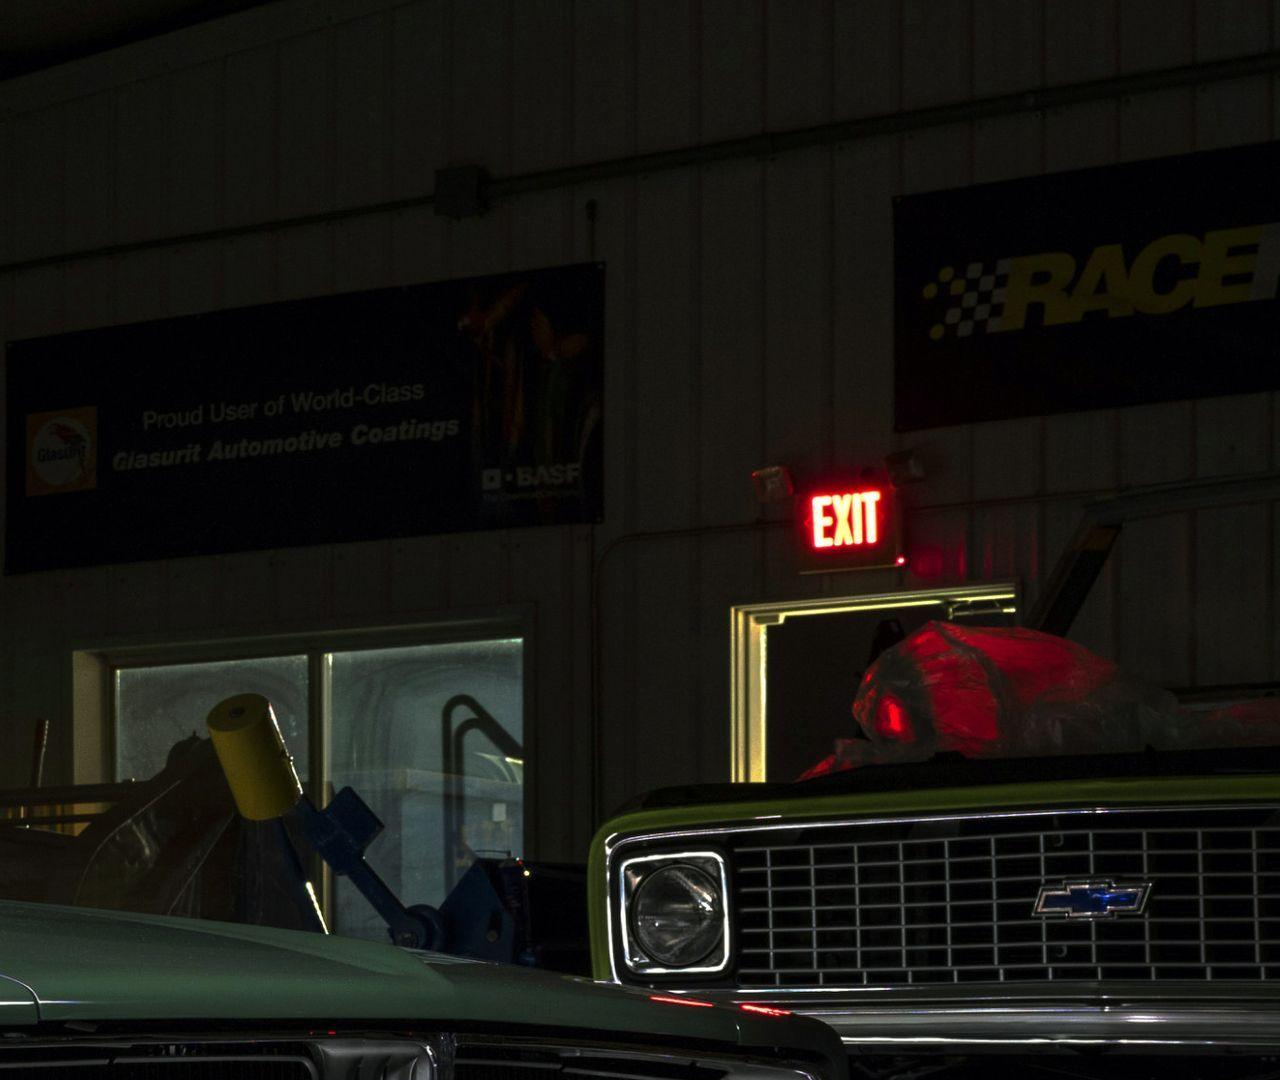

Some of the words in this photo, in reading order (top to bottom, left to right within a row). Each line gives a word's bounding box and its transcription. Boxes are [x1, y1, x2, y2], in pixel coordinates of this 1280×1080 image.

[985, 223, 1280, 334] RACE
[142, 406, 205, 433] Proud
[209, 401, 259, 426] User
[265, 398, 286, 418] of
[290, 382, 425, 414] World-Class
[112, 441, 203, 473] Glasurit
[208, 430, 344, 464] Automotive
[350, 417, 460, 450] Coatings
[516, 461, 581, 486] BASF
[811, 490, 881, 549] EXIT
